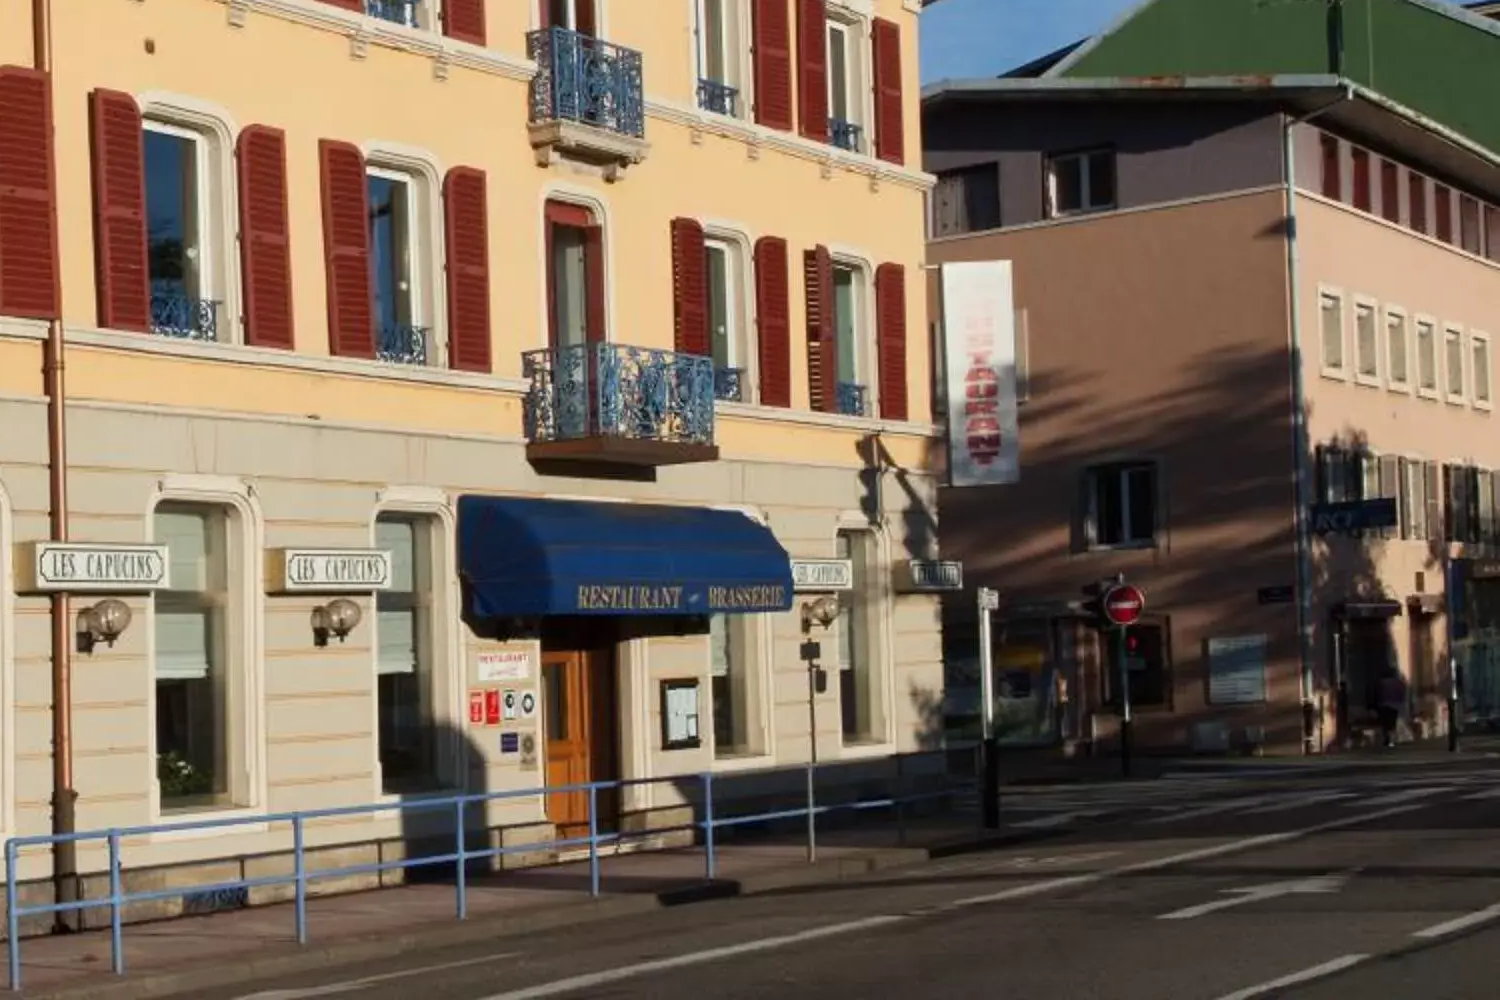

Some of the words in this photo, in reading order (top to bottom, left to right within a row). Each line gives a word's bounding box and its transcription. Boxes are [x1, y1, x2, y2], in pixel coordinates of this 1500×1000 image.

[53, 553, 75, 577] LES
[86, 554, 152, 579] CAPUCINS
[297, 557, 315, 580] LES
[325, 558, 380, 581] CAPUCINS
[578, 585, 683, 609] RESTAURANT
[708, 585, 785, 609] BRASSERIE
